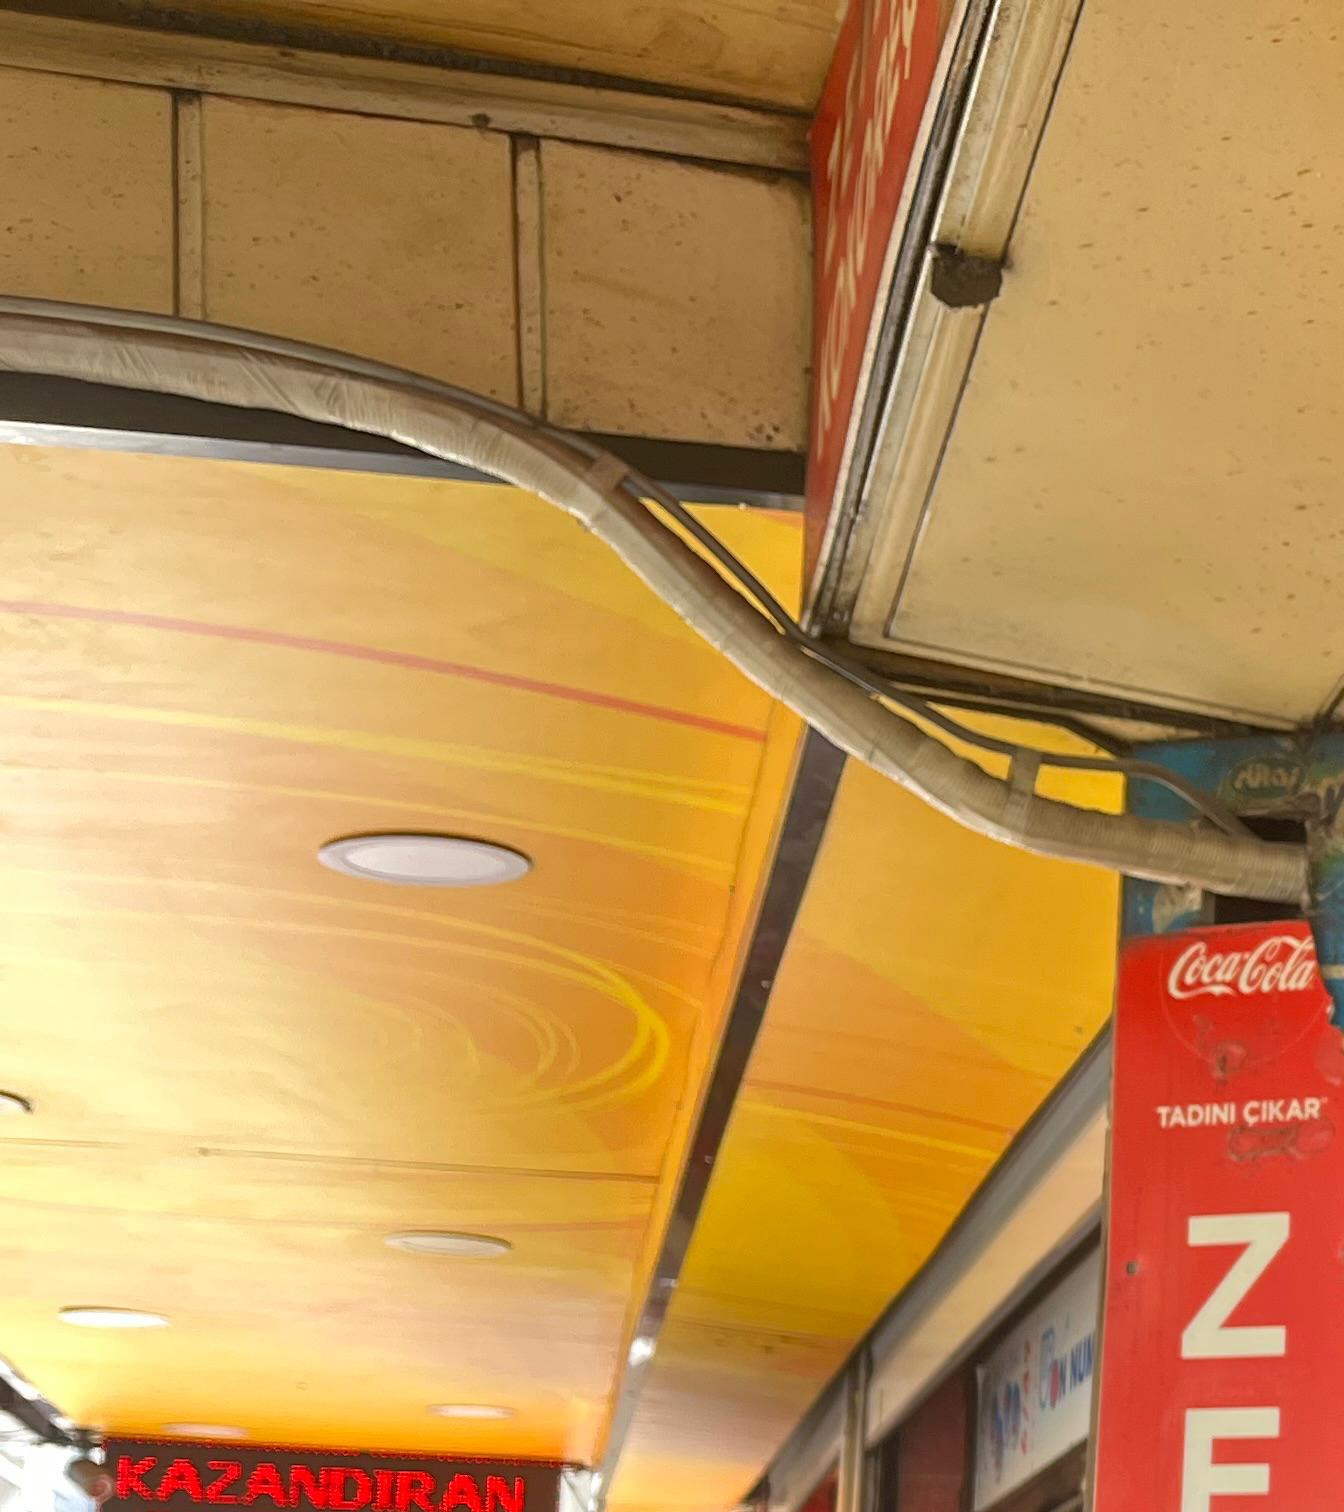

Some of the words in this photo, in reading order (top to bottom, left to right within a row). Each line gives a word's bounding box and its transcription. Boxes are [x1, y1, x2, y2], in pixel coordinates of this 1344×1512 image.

[1168, 935, 1318, 1000] Coca-Cola
[1156, 1102, 1236, 1129] TADINI
[1243, 1097, 1321, 1126] ÇIKAR
